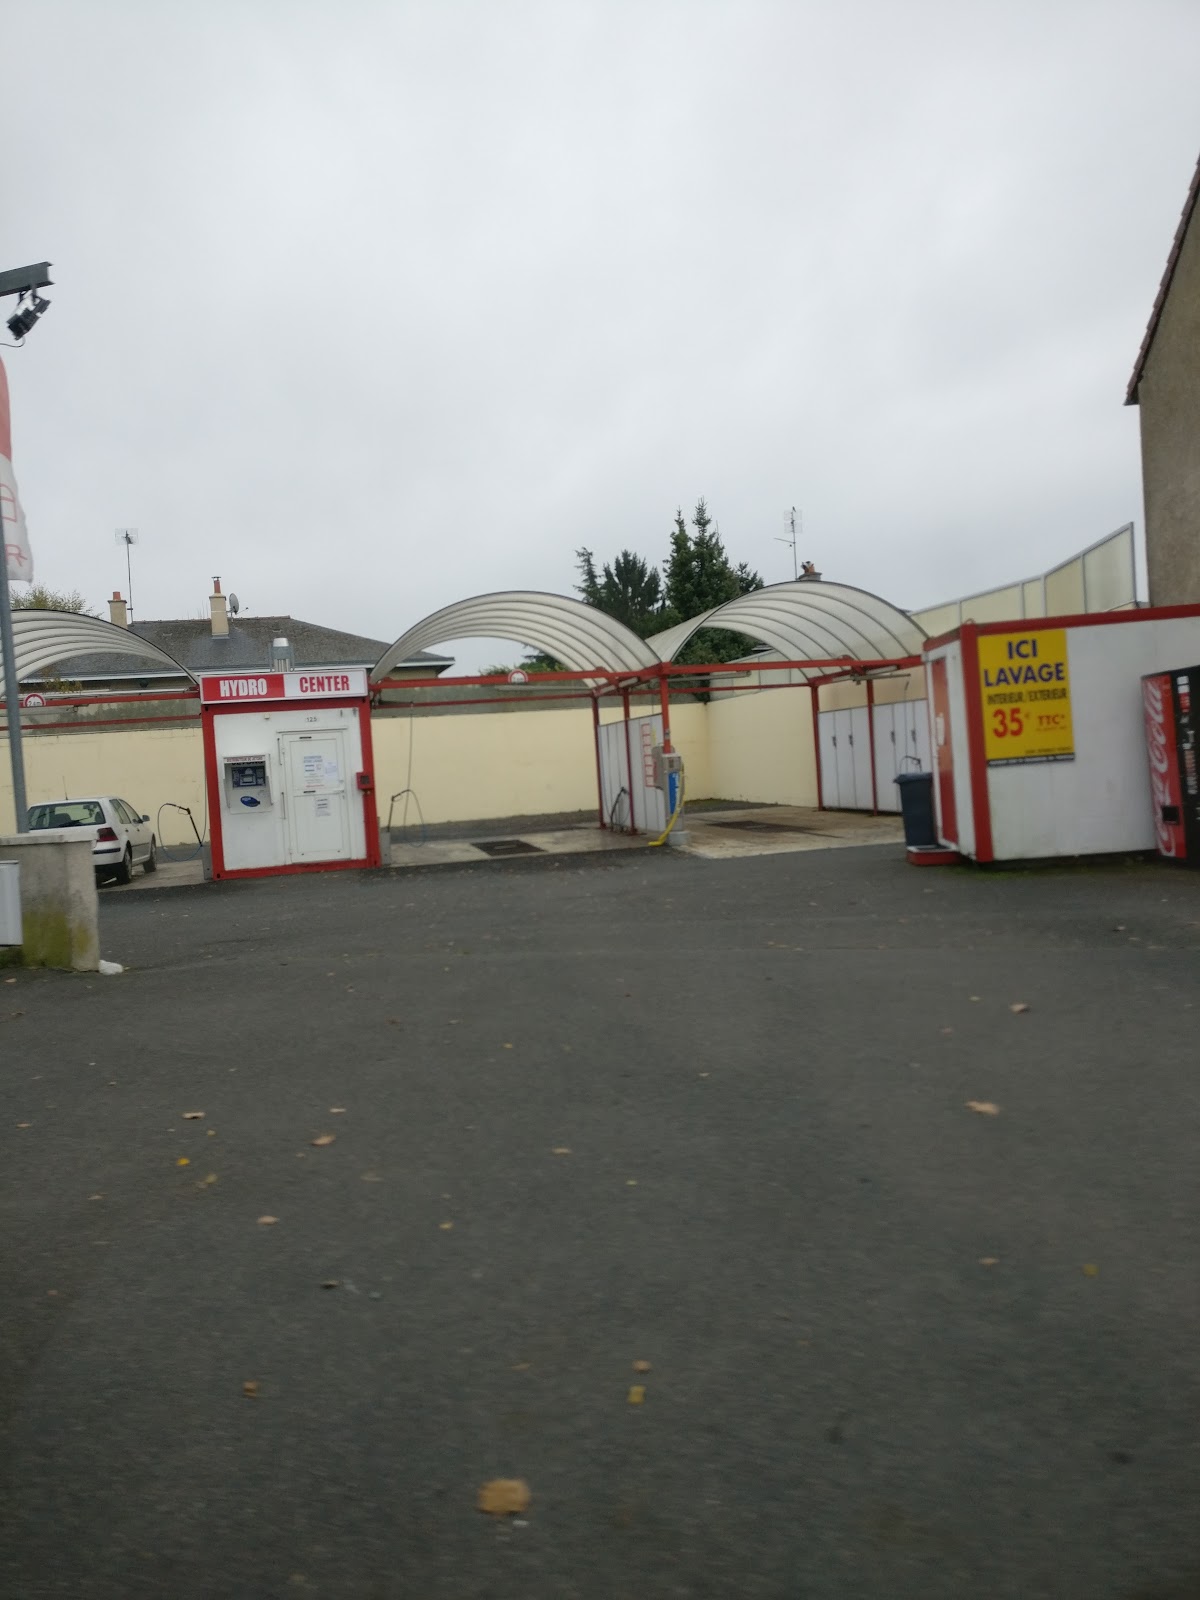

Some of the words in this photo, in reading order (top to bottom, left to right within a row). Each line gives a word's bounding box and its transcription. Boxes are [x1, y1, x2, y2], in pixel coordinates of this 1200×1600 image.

[1007, 639, 1038, 659] ICI
[984, 662, 1065, 687] LAVAGE
[219, 678, 268, 697] HYDRO
[299, 675, 350, 693] CENTER
